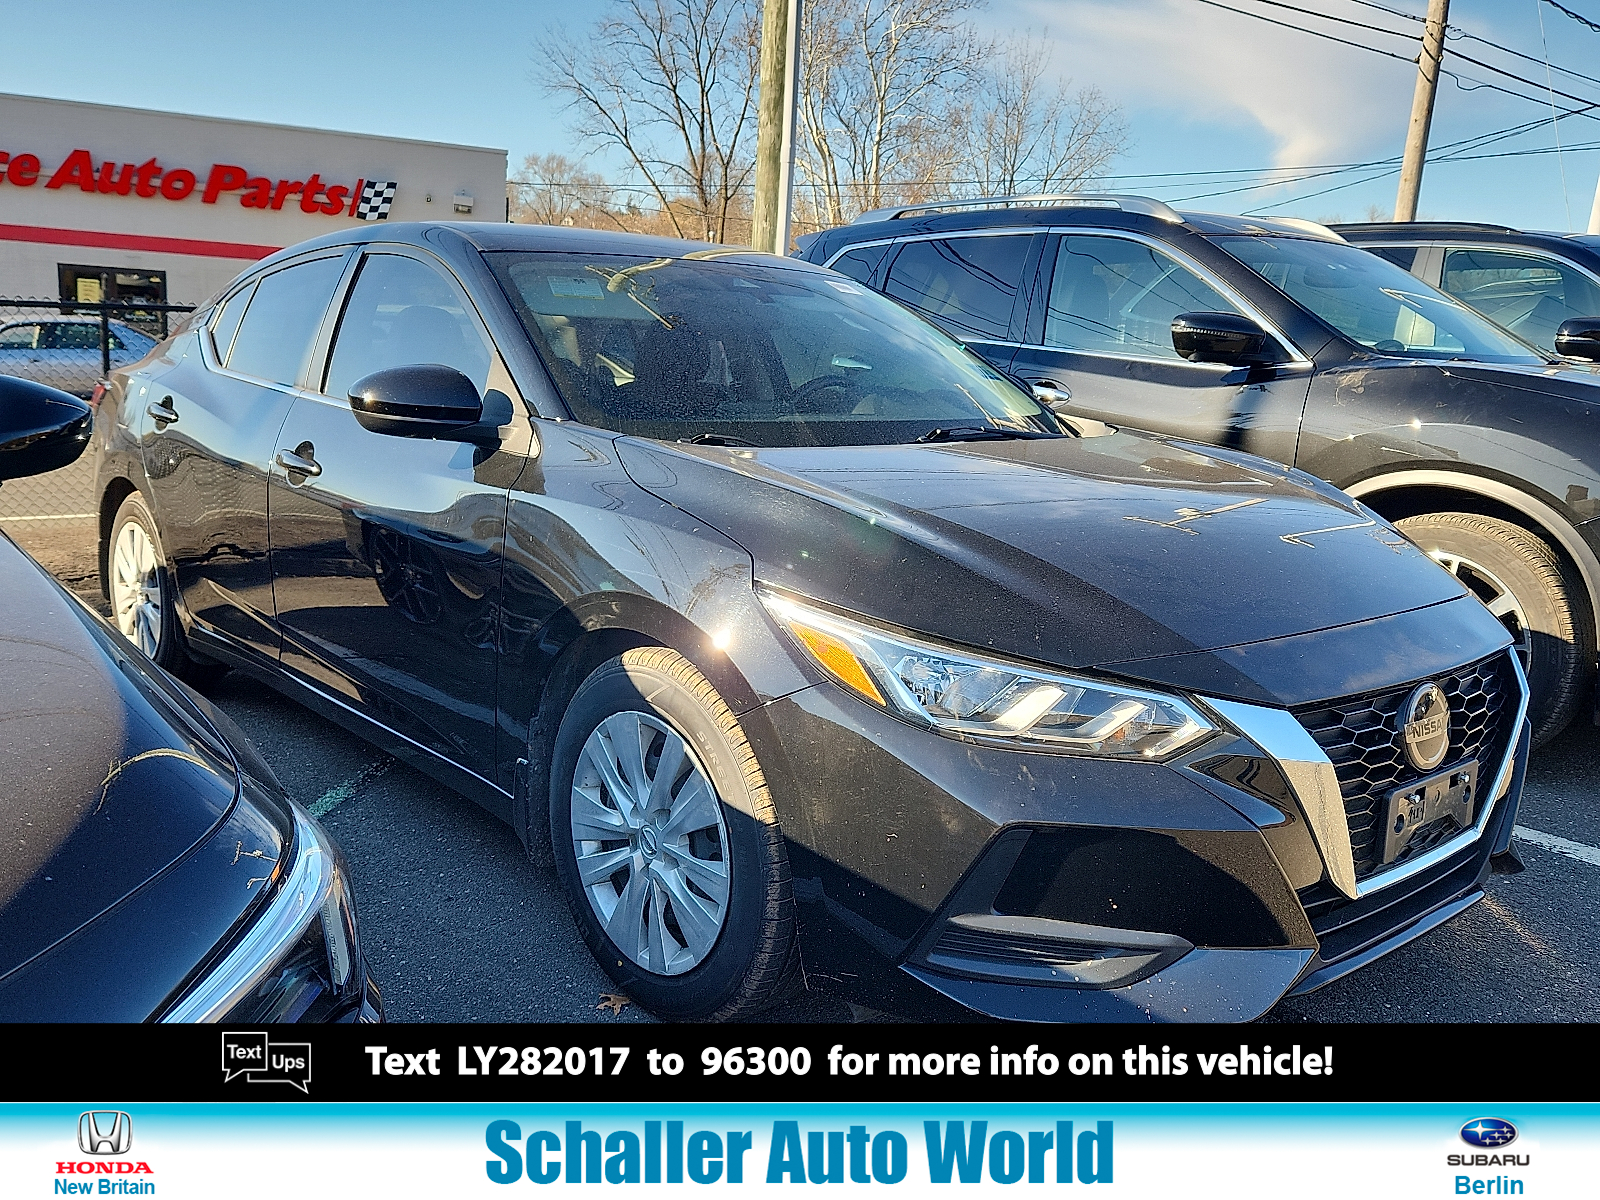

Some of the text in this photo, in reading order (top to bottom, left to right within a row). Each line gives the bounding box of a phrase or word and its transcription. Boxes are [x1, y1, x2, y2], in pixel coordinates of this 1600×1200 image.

[46, 149, 196, 201] Auto
[203, 164, 349, 216] Parts
[1412, 716, 1445, 739] NISSA
